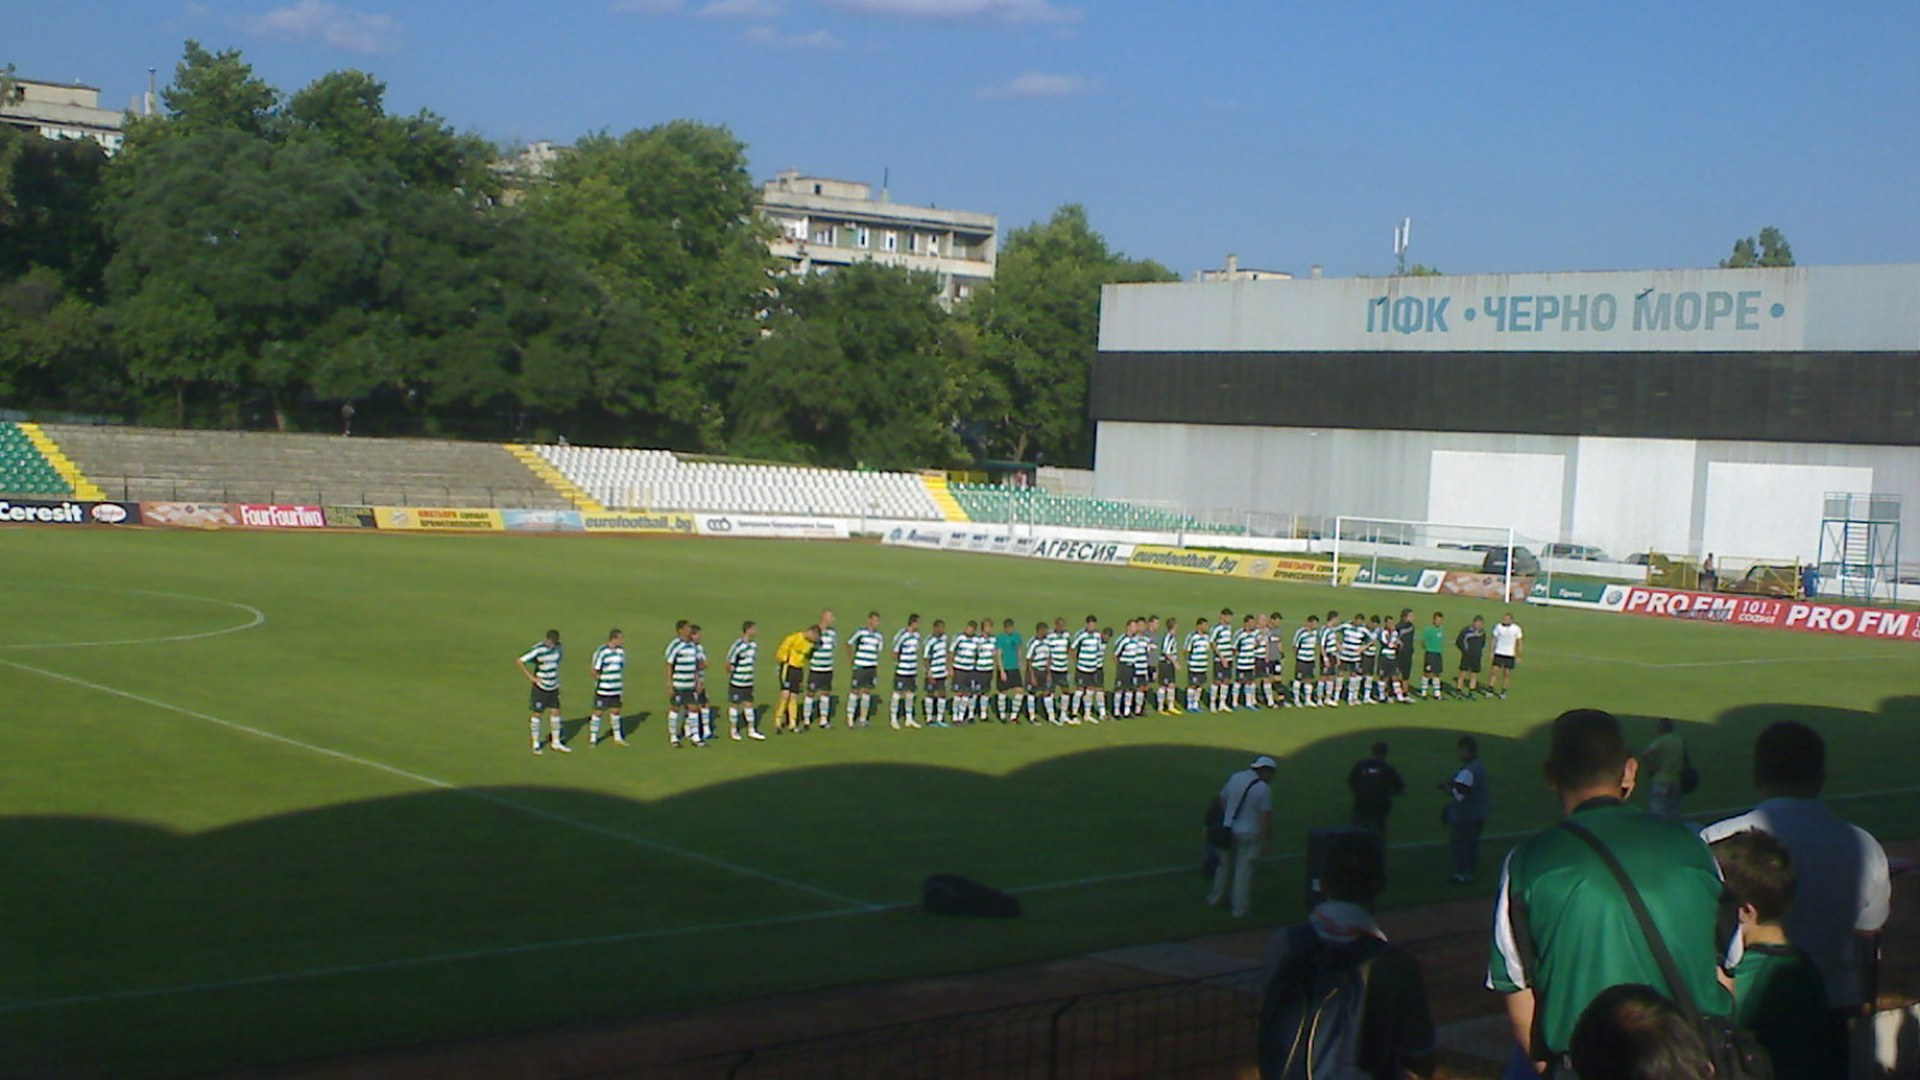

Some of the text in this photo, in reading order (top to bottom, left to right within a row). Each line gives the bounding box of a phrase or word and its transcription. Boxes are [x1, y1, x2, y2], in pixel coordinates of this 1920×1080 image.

[1366, 290, 1762, 334] ПФК ЧЕРНО МОРЕ
[0, 501, 83, 522] Ceresit
[240, 505, 324, 526] FourFourTwo
[1033, 539, 1118, 561] АГРЕСИЯ
[1627, 590, 1738, 619] PRO FM
[1742, 600, 1781, 615] 101.1
[1786, 604, 1855, 631] PRO
[1857, 610, 1910, 636] FM
